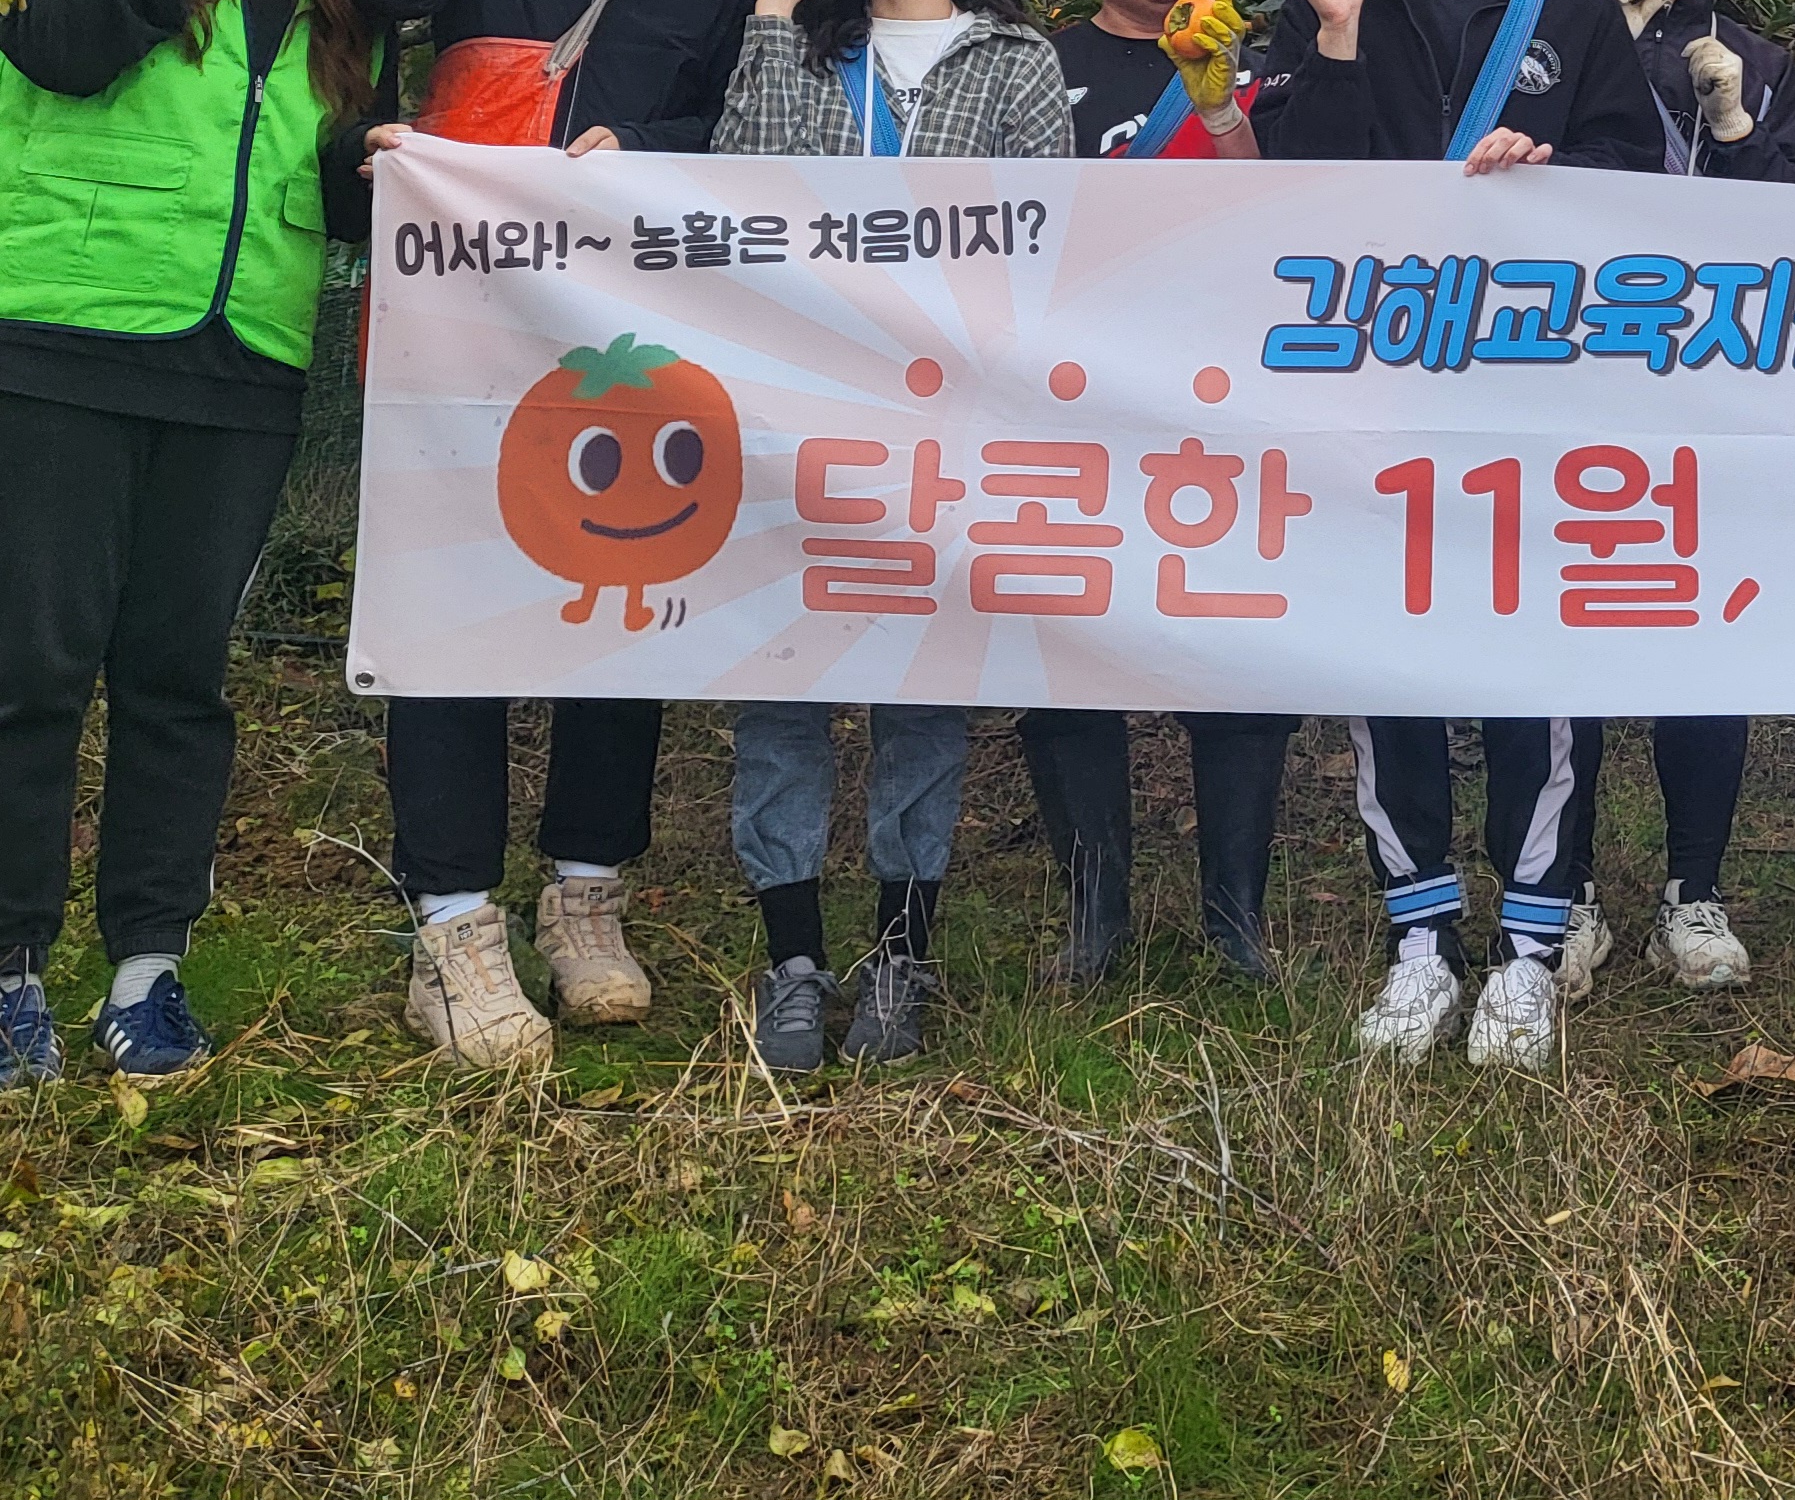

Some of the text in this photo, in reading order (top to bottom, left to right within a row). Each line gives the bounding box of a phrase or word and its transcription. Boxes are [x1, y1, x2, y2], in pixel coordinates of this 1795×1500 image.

[395, 198, 1048, 278] 어서와!~ 농활은 처음이지?
[795, 436, 1313, 618] 달콤한
[1373, 444, 1762, 628] 11월,
